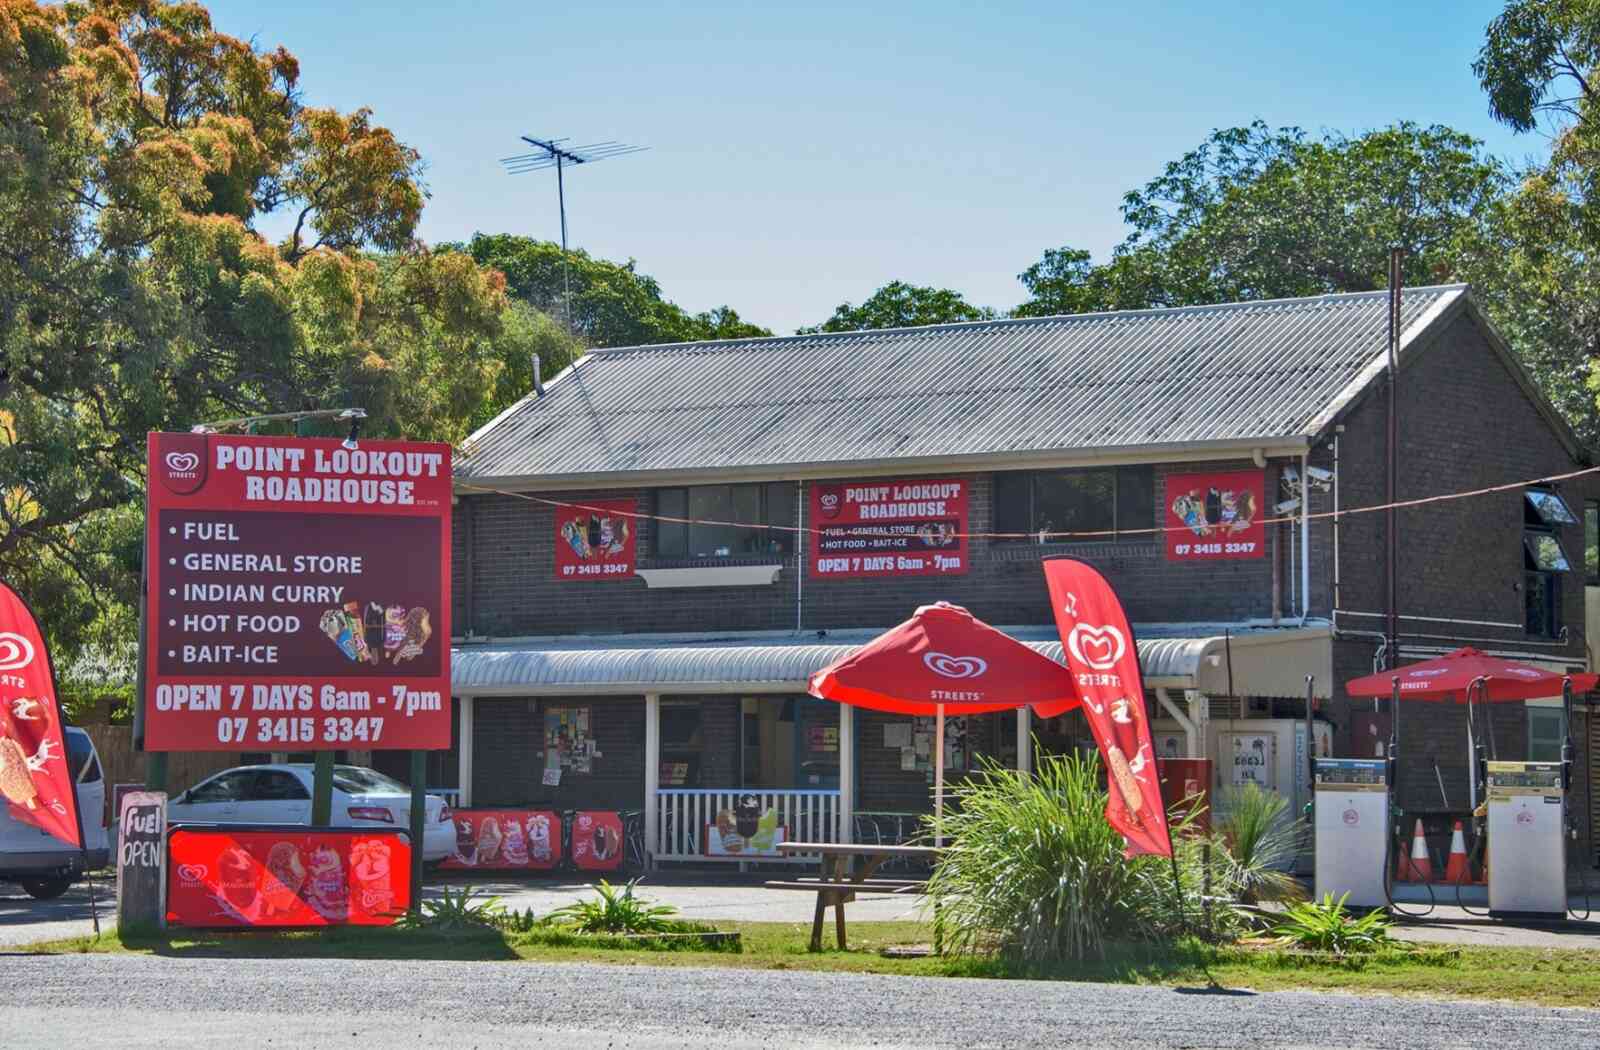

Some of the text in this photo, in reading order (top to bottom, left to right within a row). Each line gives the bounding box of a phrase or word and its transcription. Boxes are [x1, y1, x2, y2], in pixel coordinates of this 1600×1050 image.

[217, 446, 442, 477] POINT LOOKOUT
[247, 476, 415, 505] ROADHOUSE
[846, 484, 961, 503] POINT LOOKOUT
[860, 502, 946, 519] ROADHOUSE
[184, 523, 240, 541] FUEL
[852, 527, 888, 536] GENERAL
[890, 526, 915, 534] STORE
[826, 539, 907, 549] HOT FOOD BAIT-ICE
[1176, 543, 1256, 555] 07 3415 3347
[184, 554, 362, 573] GENERAL STORE
[563, 564, 628, 576] 07 3415 3347
[818, 559, 848, 572] OPEN
[853, 558, 860, 571] 7
[864, 557, 894, 571] DAYS
[898, 556, 923, 569] 6am
[935, 555, 961, 571] 7pm
[184, 584, 344, 604] INDIAN CURRY
[184, 615, 300, 633] HOT FOOD
[183, 646, 278, 664] BAIT-ICE
[156, 685, 222, 710] OPEN
[230, 685, 245, 710] 7
[252, 685, 313, 711] DAYS
[321, 685, 371, 711] 6am
[393, 686, 441, 716] 7pm
[931, 690, 980, 701] STREETS
[218, 718, 384, 742] 07 3415 3347
[124, 840, 160, 867] OPEN
